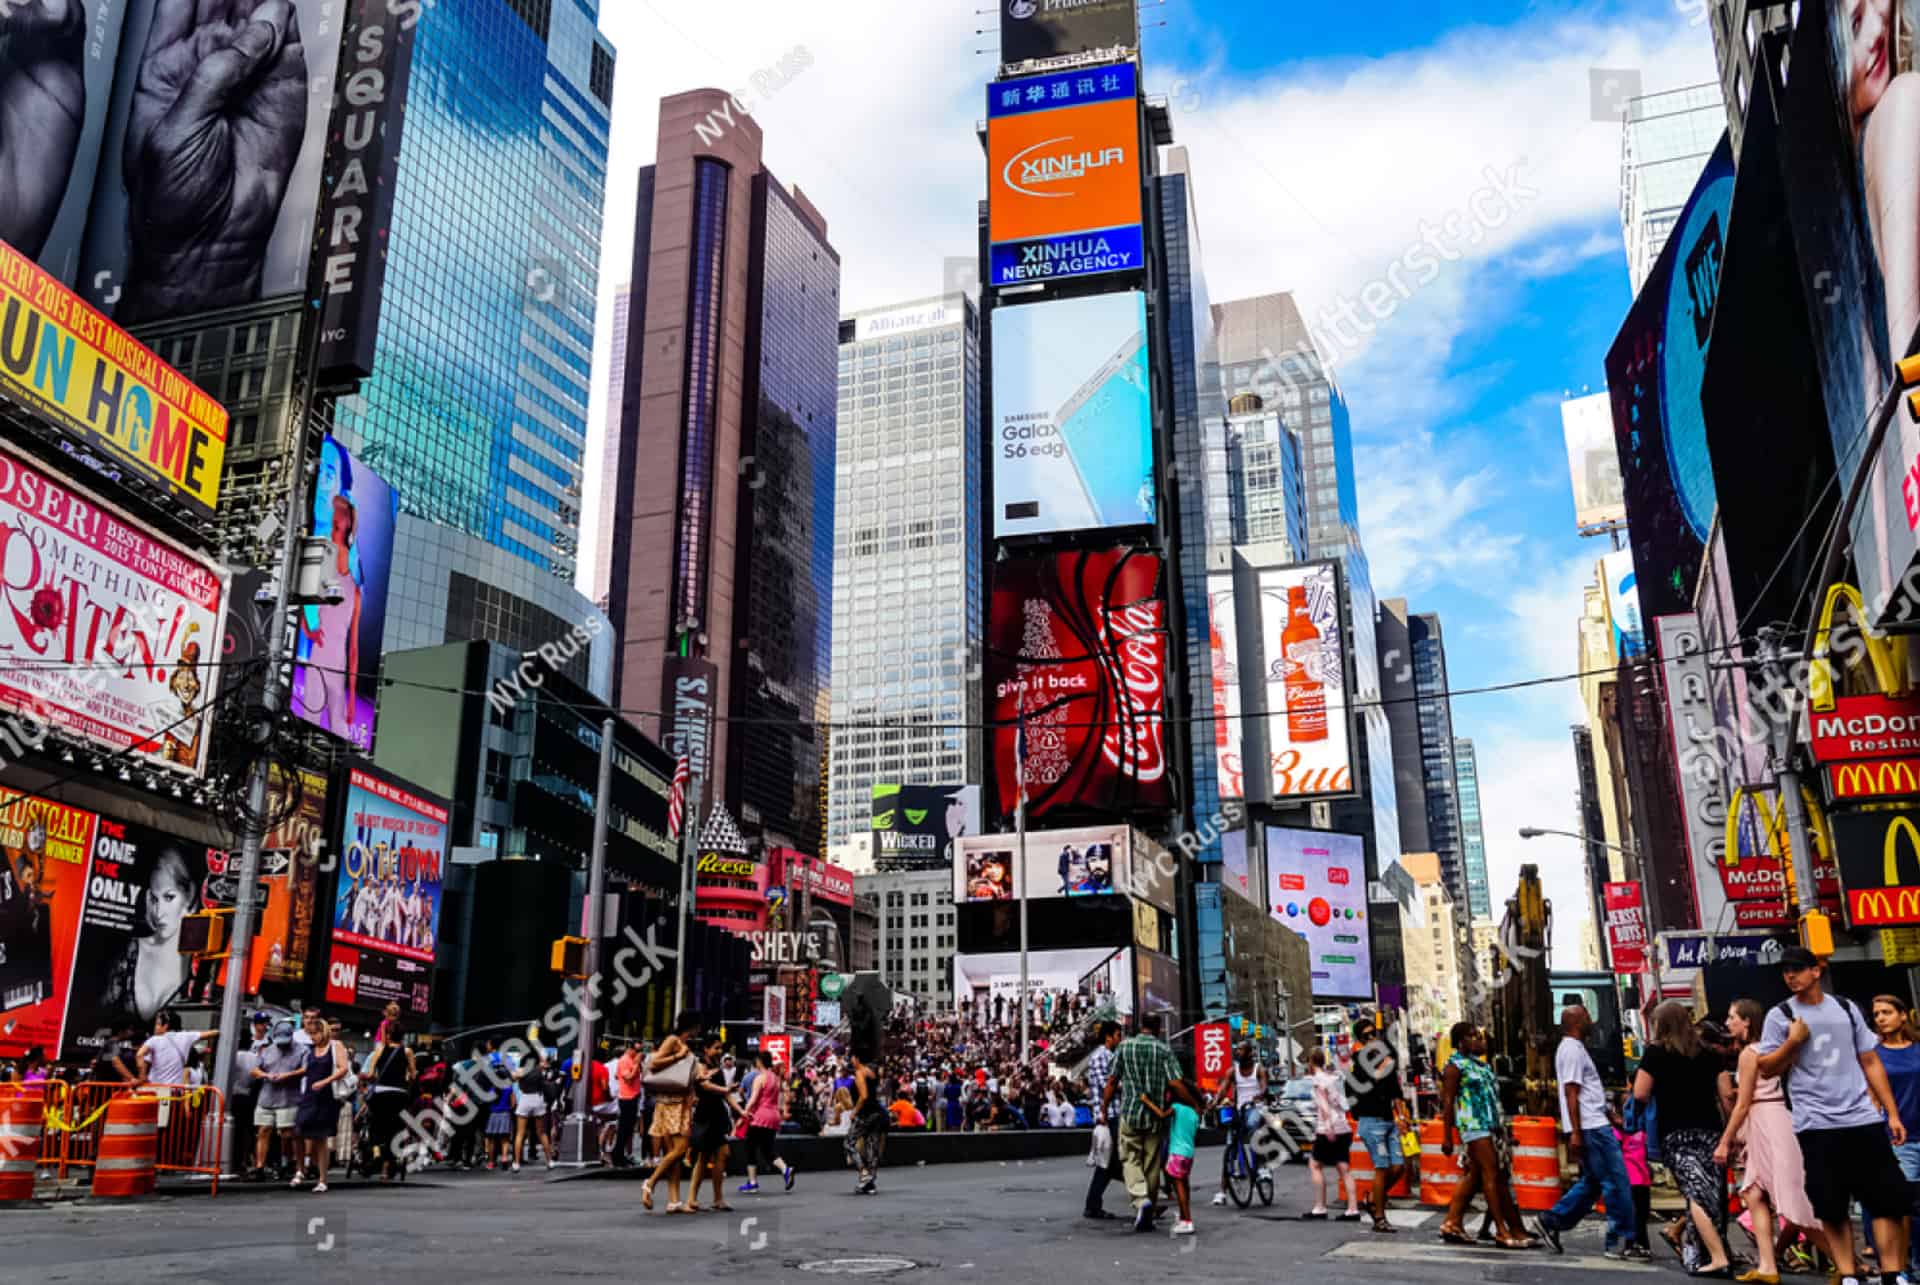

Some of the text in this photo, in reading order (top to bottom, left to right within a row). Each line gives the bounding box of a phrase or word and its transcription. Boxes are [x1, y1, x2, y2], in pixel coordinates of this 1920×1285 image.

[1001, 74, 1121, 108] 新华通讯社
[325, 25, 385, 295] SQUARE
[1021, 147, 1124, 178] XINHUA
[1023, 238, 1110, 263] XINHUA
[1003, 252, 1131, 281] NEWS AGENCY
[868, 312, 927, 333] Allianz
[35, 274, 70, 323] 2015
[70, 302, 105, 347] BEST
[104, 325, 159, 387] MUSICAL
[160, 367, 190, 413] TONY
[88, 358, 209, 494] HOME
[1004, 411, 1049, 423] SAMSUNG
[1004, 443, 1027, 459] S6
[105, 521, 144, 554] BEST
[16, 511, 167, 608] SOMETHING
[104, 540, 128, 562] 2015
[133, 553, 167, 580] TONY
[997, 673, 1087, 698] give it back
[1099, 598, 1166, 785] Coca-Cola
[100, 819, 127, 840] THE
[97, 836, 137, 865] ONE
[345, 842, 373, 881] ON
[399, 846, 441, 882] TOWN
[94, 860, 120, 879] THE
[90, 877, 141, 906] ONLY
[1740, 909, 1774, 920] OPEN
[329, 961, 357, 991] CNN
[1203, 1027, 1225, 1073] tkts
